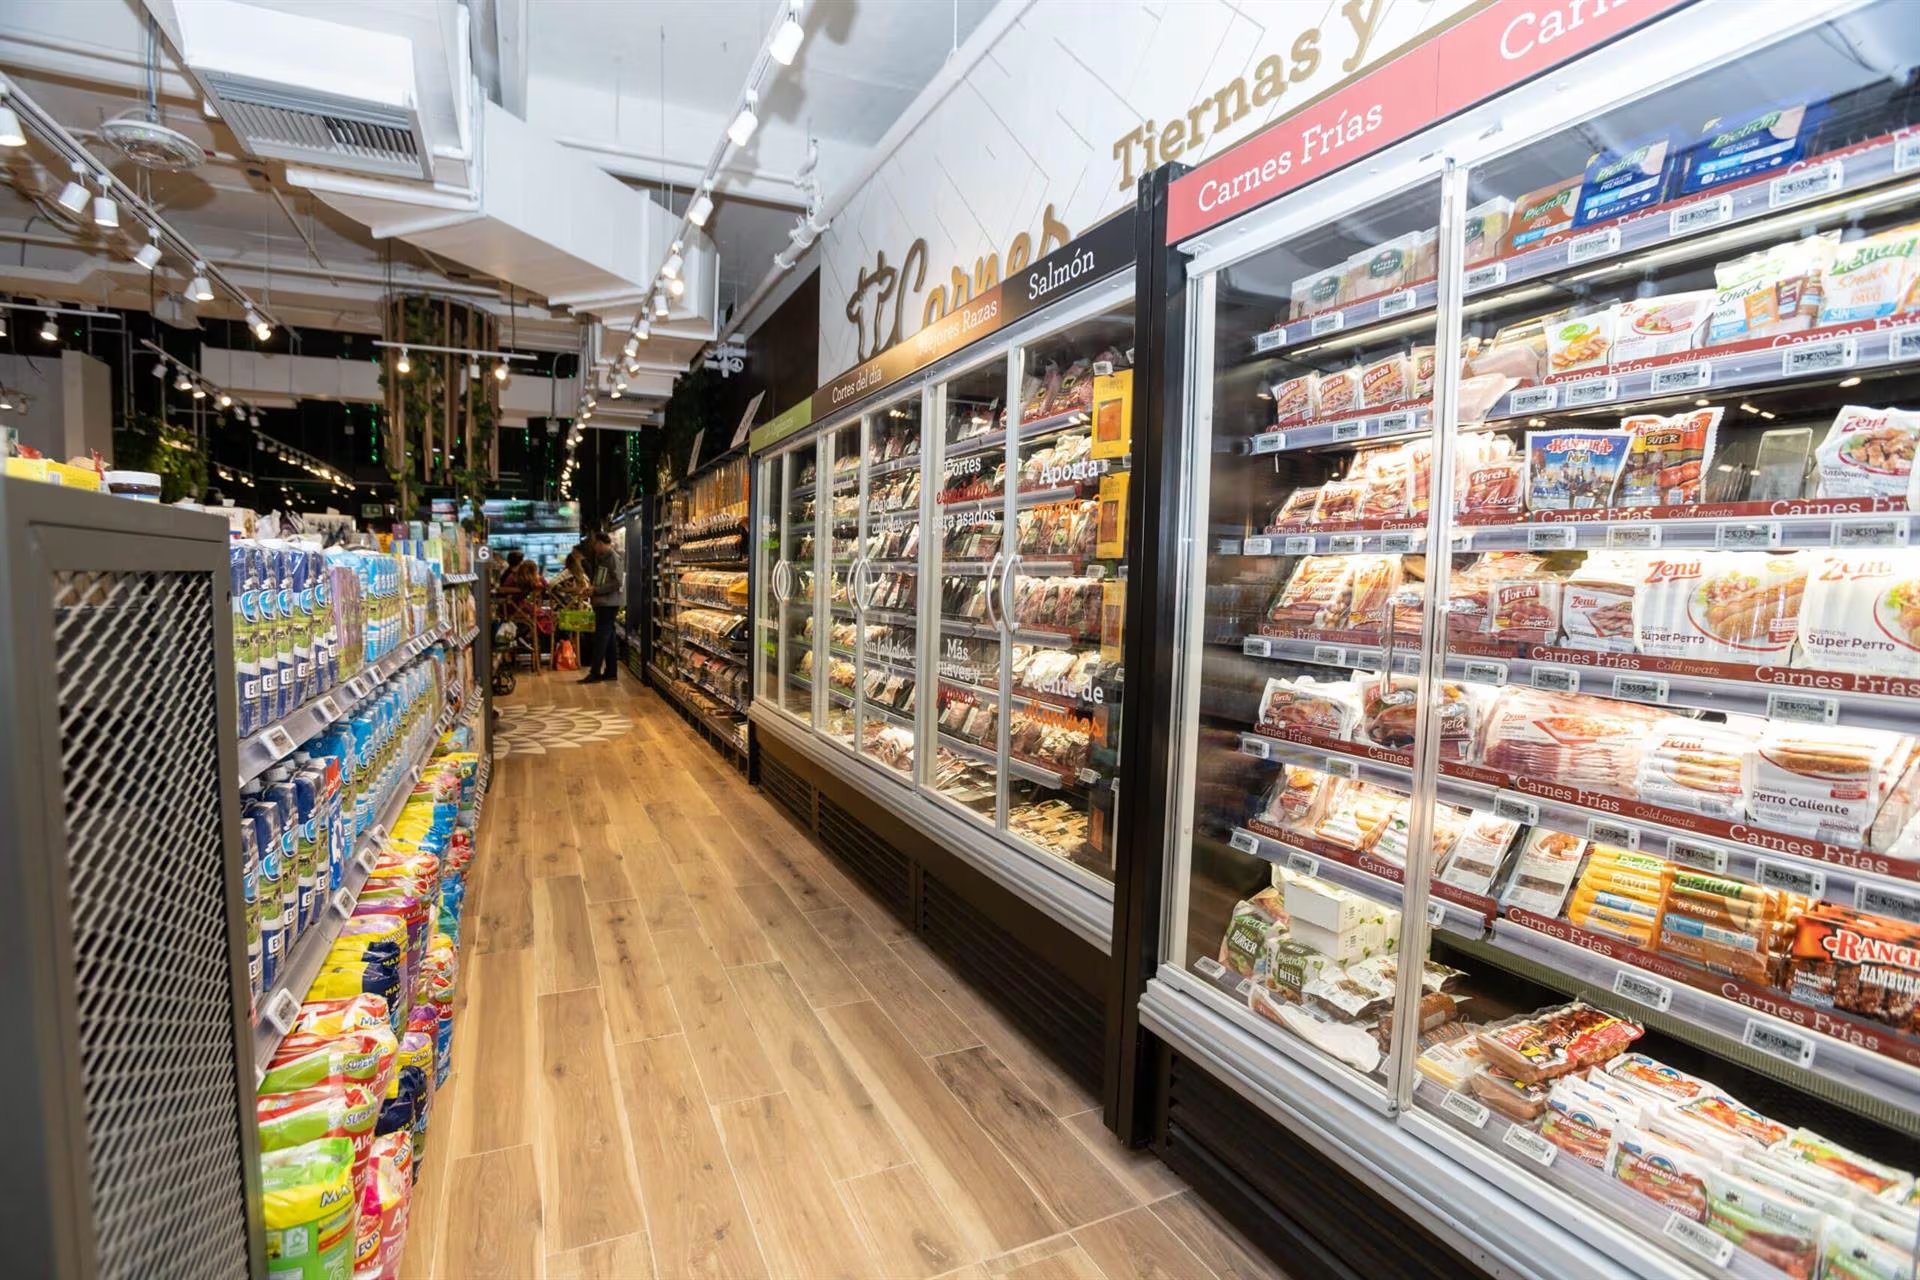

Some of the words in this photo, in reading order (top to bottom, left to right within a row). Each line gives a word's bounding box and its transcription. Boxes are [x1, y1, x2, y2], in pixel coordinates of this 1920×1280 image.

[1112, 27, 1322, 192] Tiernas
[1341, 0, 1384, 72] y
[1198, 150, 1292, 212] Carnes
[1300, 104, 1384, 165] Frías
[1028, 248, 1095, 300] Salmón
[1719, 281, 1763, 306] Snack
[962, 300, 998, 333] Razas
[832, 381, 855, 404] Cortes
[856, 372, 868, 392] del
[869, 365, 882, 388] día
[1363, 365, 1390, 388] Porchi
[1039, 458, 1098, 488] Aporta
[956, 503, 996, 528] asados
[1541, 510, 1601, 523] Carnes
[1608, 509, 1652, 522] Frías
[1668, 508, 1696, 519] Cold
[1699, 508, 1734, 518] meats
[1771, 500, 1861, 516] Carnes
[478, 546, 490, 560] 6
[1645, 560, 1702, 584] Zenú
[1501, 585, 1537, 604] Porchi
[1263, 625, 1295, 638] Carnes
[1297, 628, 1321, 642] Frías
[1672, 632, 1705, 645] Perro
[1808, 633, 1852, 650] Súper
[1852, 636, 1896, 652] Perro
[946, 638, 969, 661] Más
[1532, 646, 1591, 665] Carnes
[1595, 652, 1640, 670] Frías
[1656, 660, 1683, 675] Cold
[1684, 665, 1720, 676] meats
[936, 660, 970, 680] suaves
[1755, 666, 1843, 690] Carnes
[1851, 674, 1920, 698] Frías
[1081, 674, 1104, 704] de
[1254, 722, 1287, 740] Carnes
[1288, 728, 1313, 746] Frías
[1368, 746, 1410, 766] Carnes
[1516, 775, 1572, 801] Carnes
[1577, 789, 1620, 813] Frías
[1634, 806, 1661, 822] Cold
[1662, 813, 1696, 829] meats
[1752, 790, 1787, 807] Perro
[1789, 797, 1849, 816] Caliente
[1249, 818, 1280, 838] Carnes
[1281, 828, 1305, 847] Frías
[1729, 824, 1813, 857] Carnes
[1821, 844, 1889, 875] Frías
[1359, 855, 1399, 880] Carnes
[1676, 901, 1690, 911] DE
[1691, 904, 1719, 919] POLLO
[1231, 929, 1258, 955] BURGER
[1509, 909, 1565, 937] Carnes
[1569, 927, 1613, 956] Frías
[1627, 951, 1653, 968] Cold
[1654, 962, 1689, 982] meats
[1279, 967, 1301, 986] BITES
[1721, 982, 1804, 1024] Carnes
[1811, 1008, 1879, 1051] Frías
